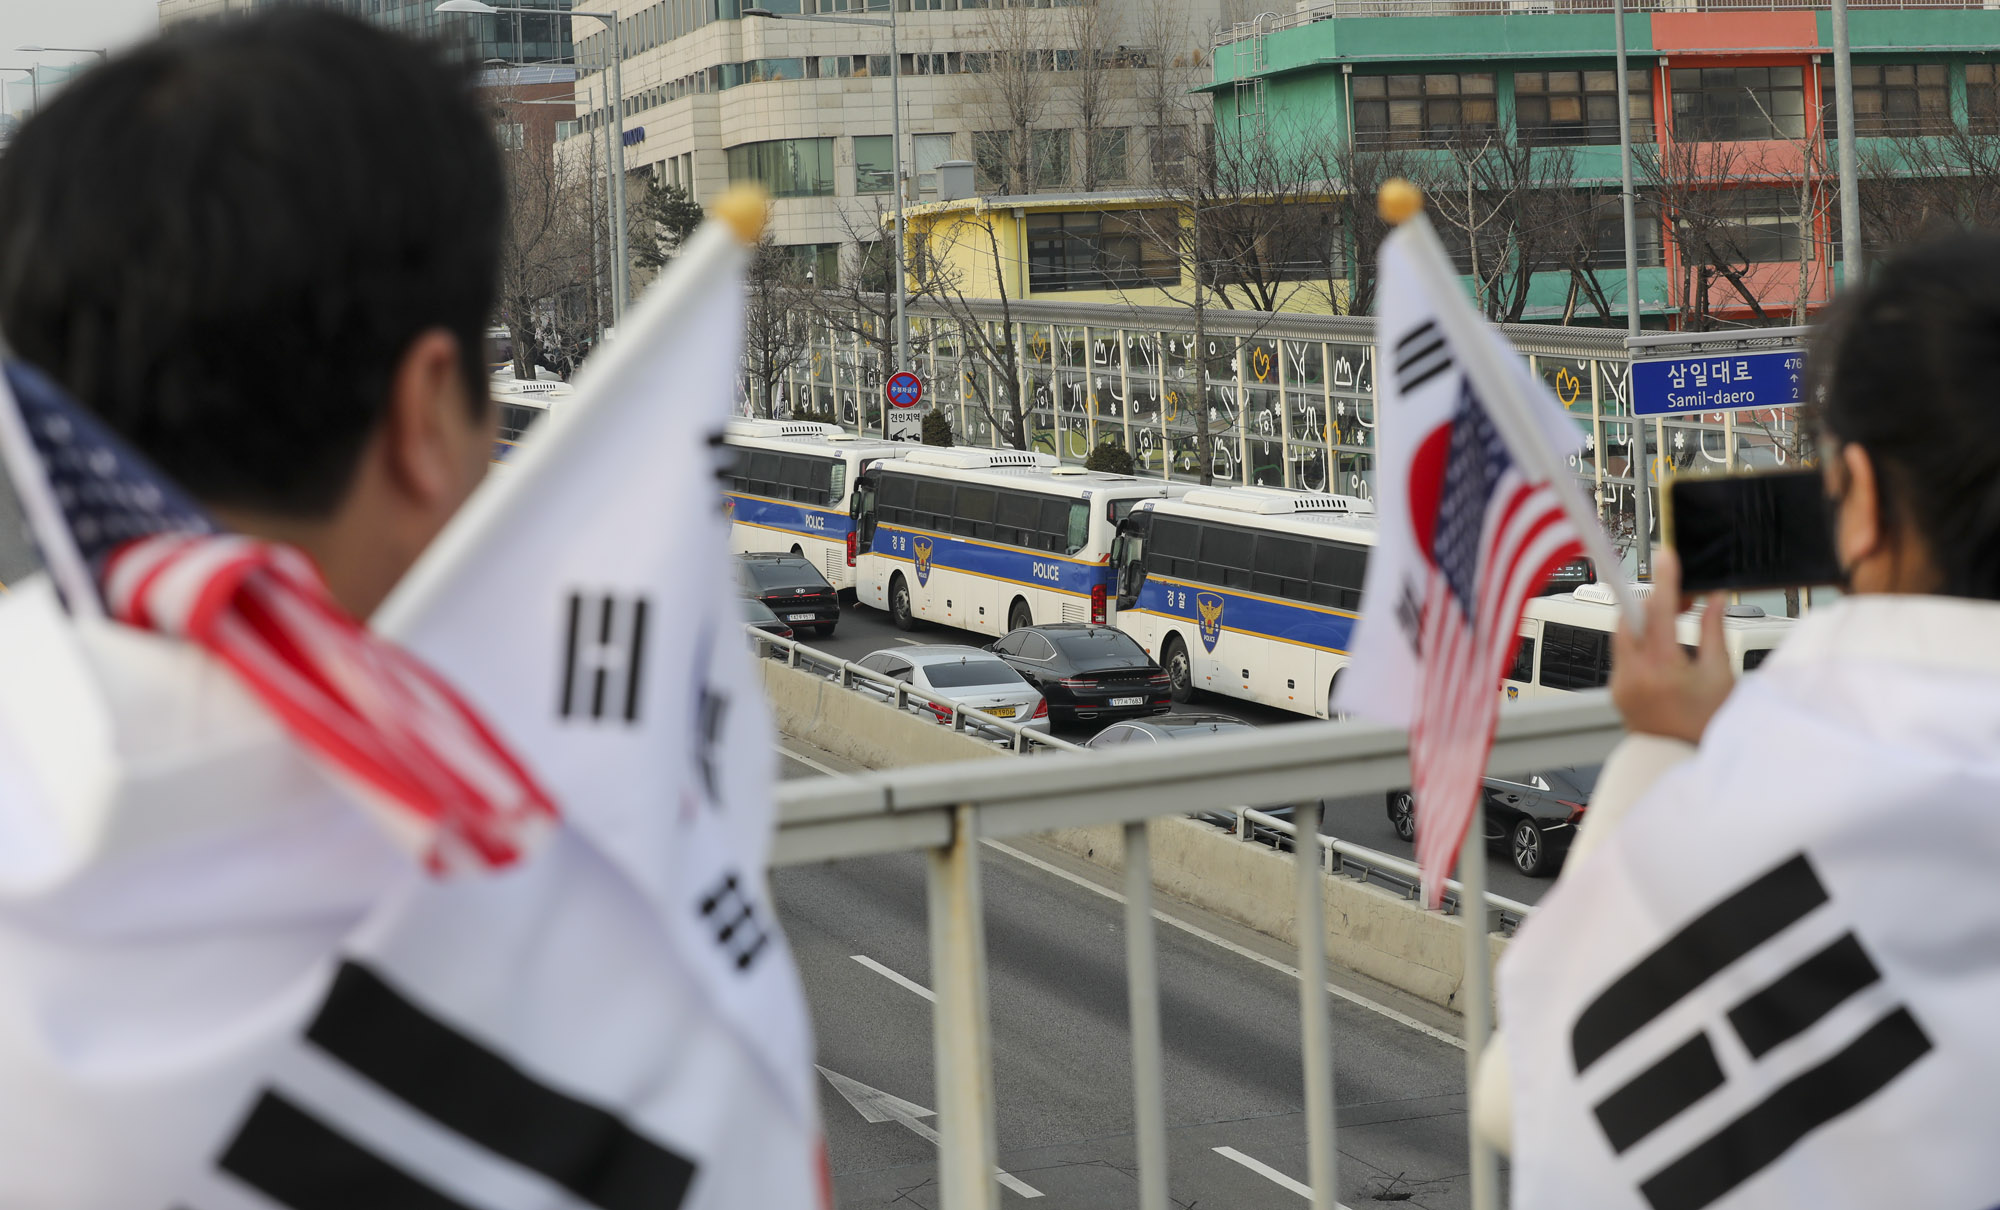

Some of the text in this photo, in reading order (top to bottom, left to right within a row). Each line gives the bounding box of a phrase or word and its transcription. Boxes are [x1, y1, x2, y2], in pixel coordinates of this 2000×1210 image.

[1784, 358, 1803, 370] 476
[1667, 360, 1753, 389] 삼일대로
[1667, 389, 1755, 408] Samil-daero
[890, 413, 921, 423] 견인지역
[805, 514, 825, 530] POLICE
[892, 535, 906, 551] 경찰
[1033, 561, 1060, 582] POLICE
[1167, 590, 1186, 609] 경찰
